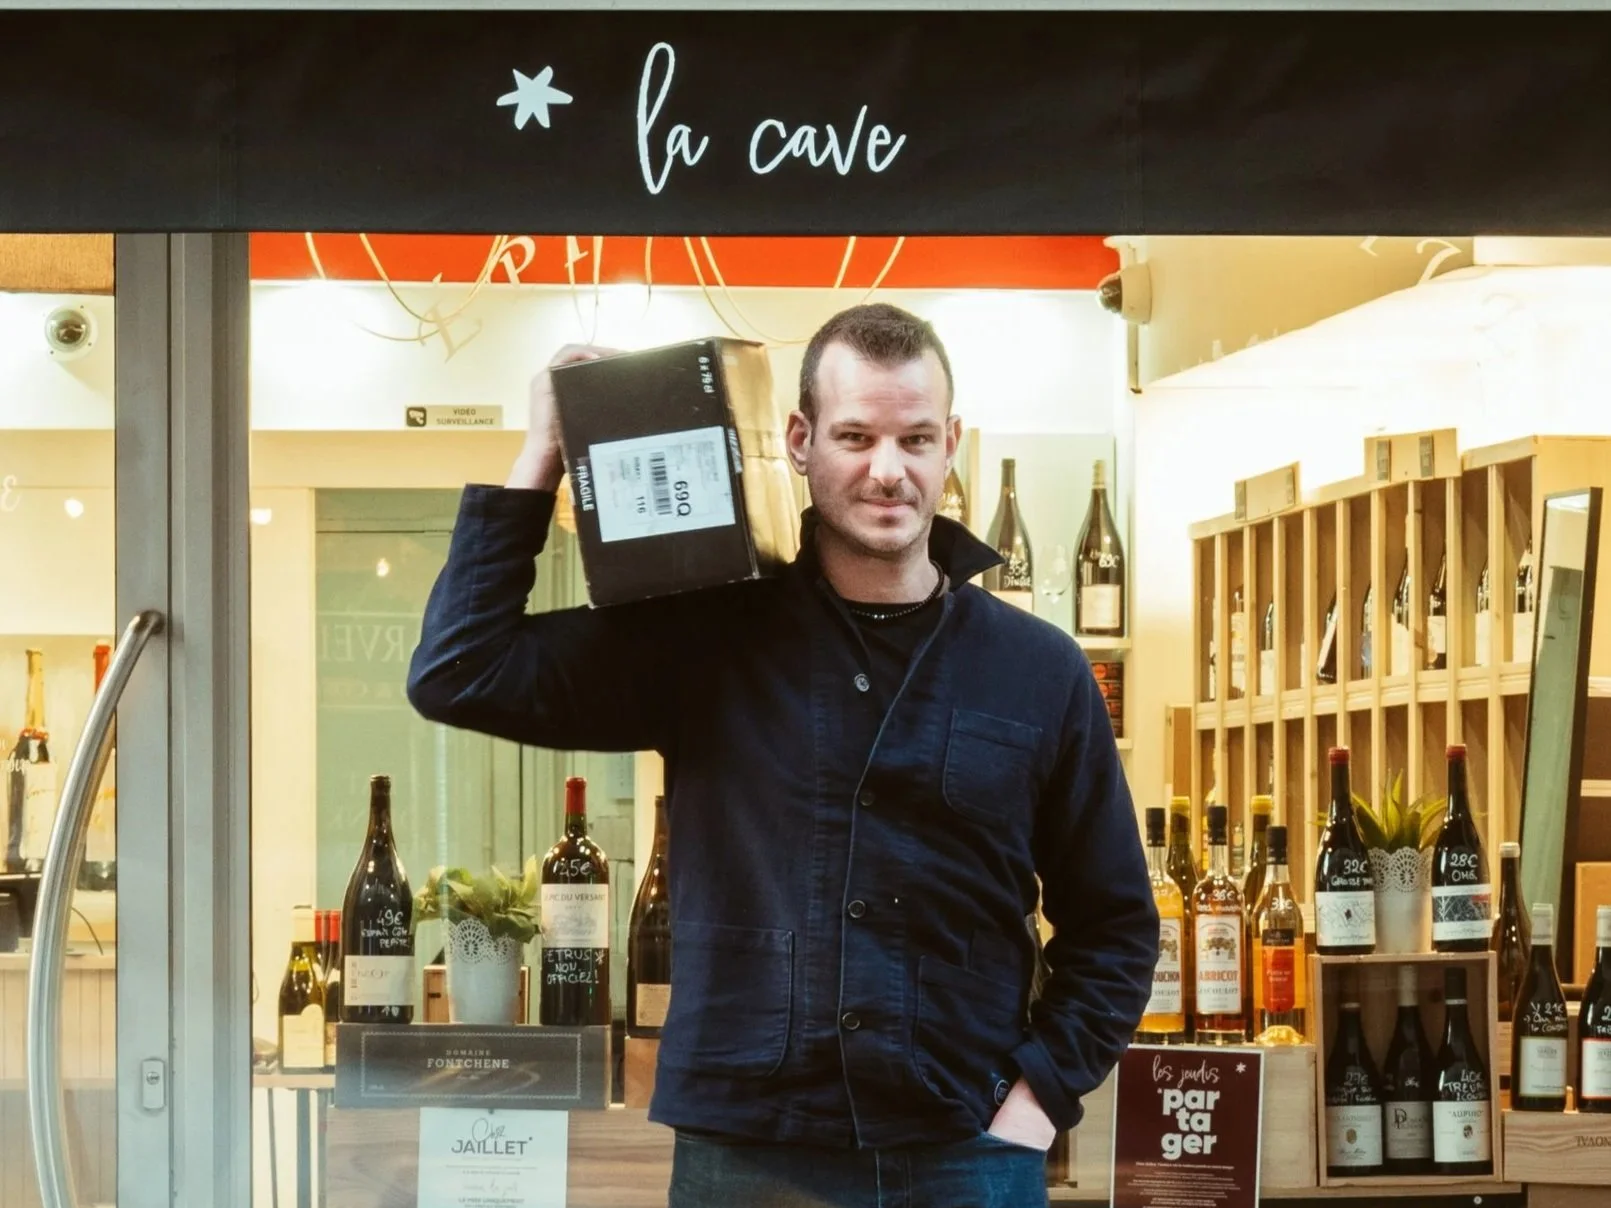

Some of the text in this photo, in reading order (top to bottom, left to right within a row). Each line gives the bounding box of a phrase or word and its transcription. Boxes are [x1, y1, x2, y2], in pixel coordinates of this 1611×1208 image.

[637, 42, 906, 194] la cave
[575, 465, 594, 512] FRAGILE
[1450, 853, 1478, 868] 28€
[427, 1058, 510, 1069] FONTCHENE
[1177, 1059, 1220, 1089] jeudis
[1162, 1088, 1220, 1116] par
[1176, 1107, 1212, 1132] ta
[451, 1139, 529, 1155] JAILLET
[1161, 1133, 1217, 1160] ger
